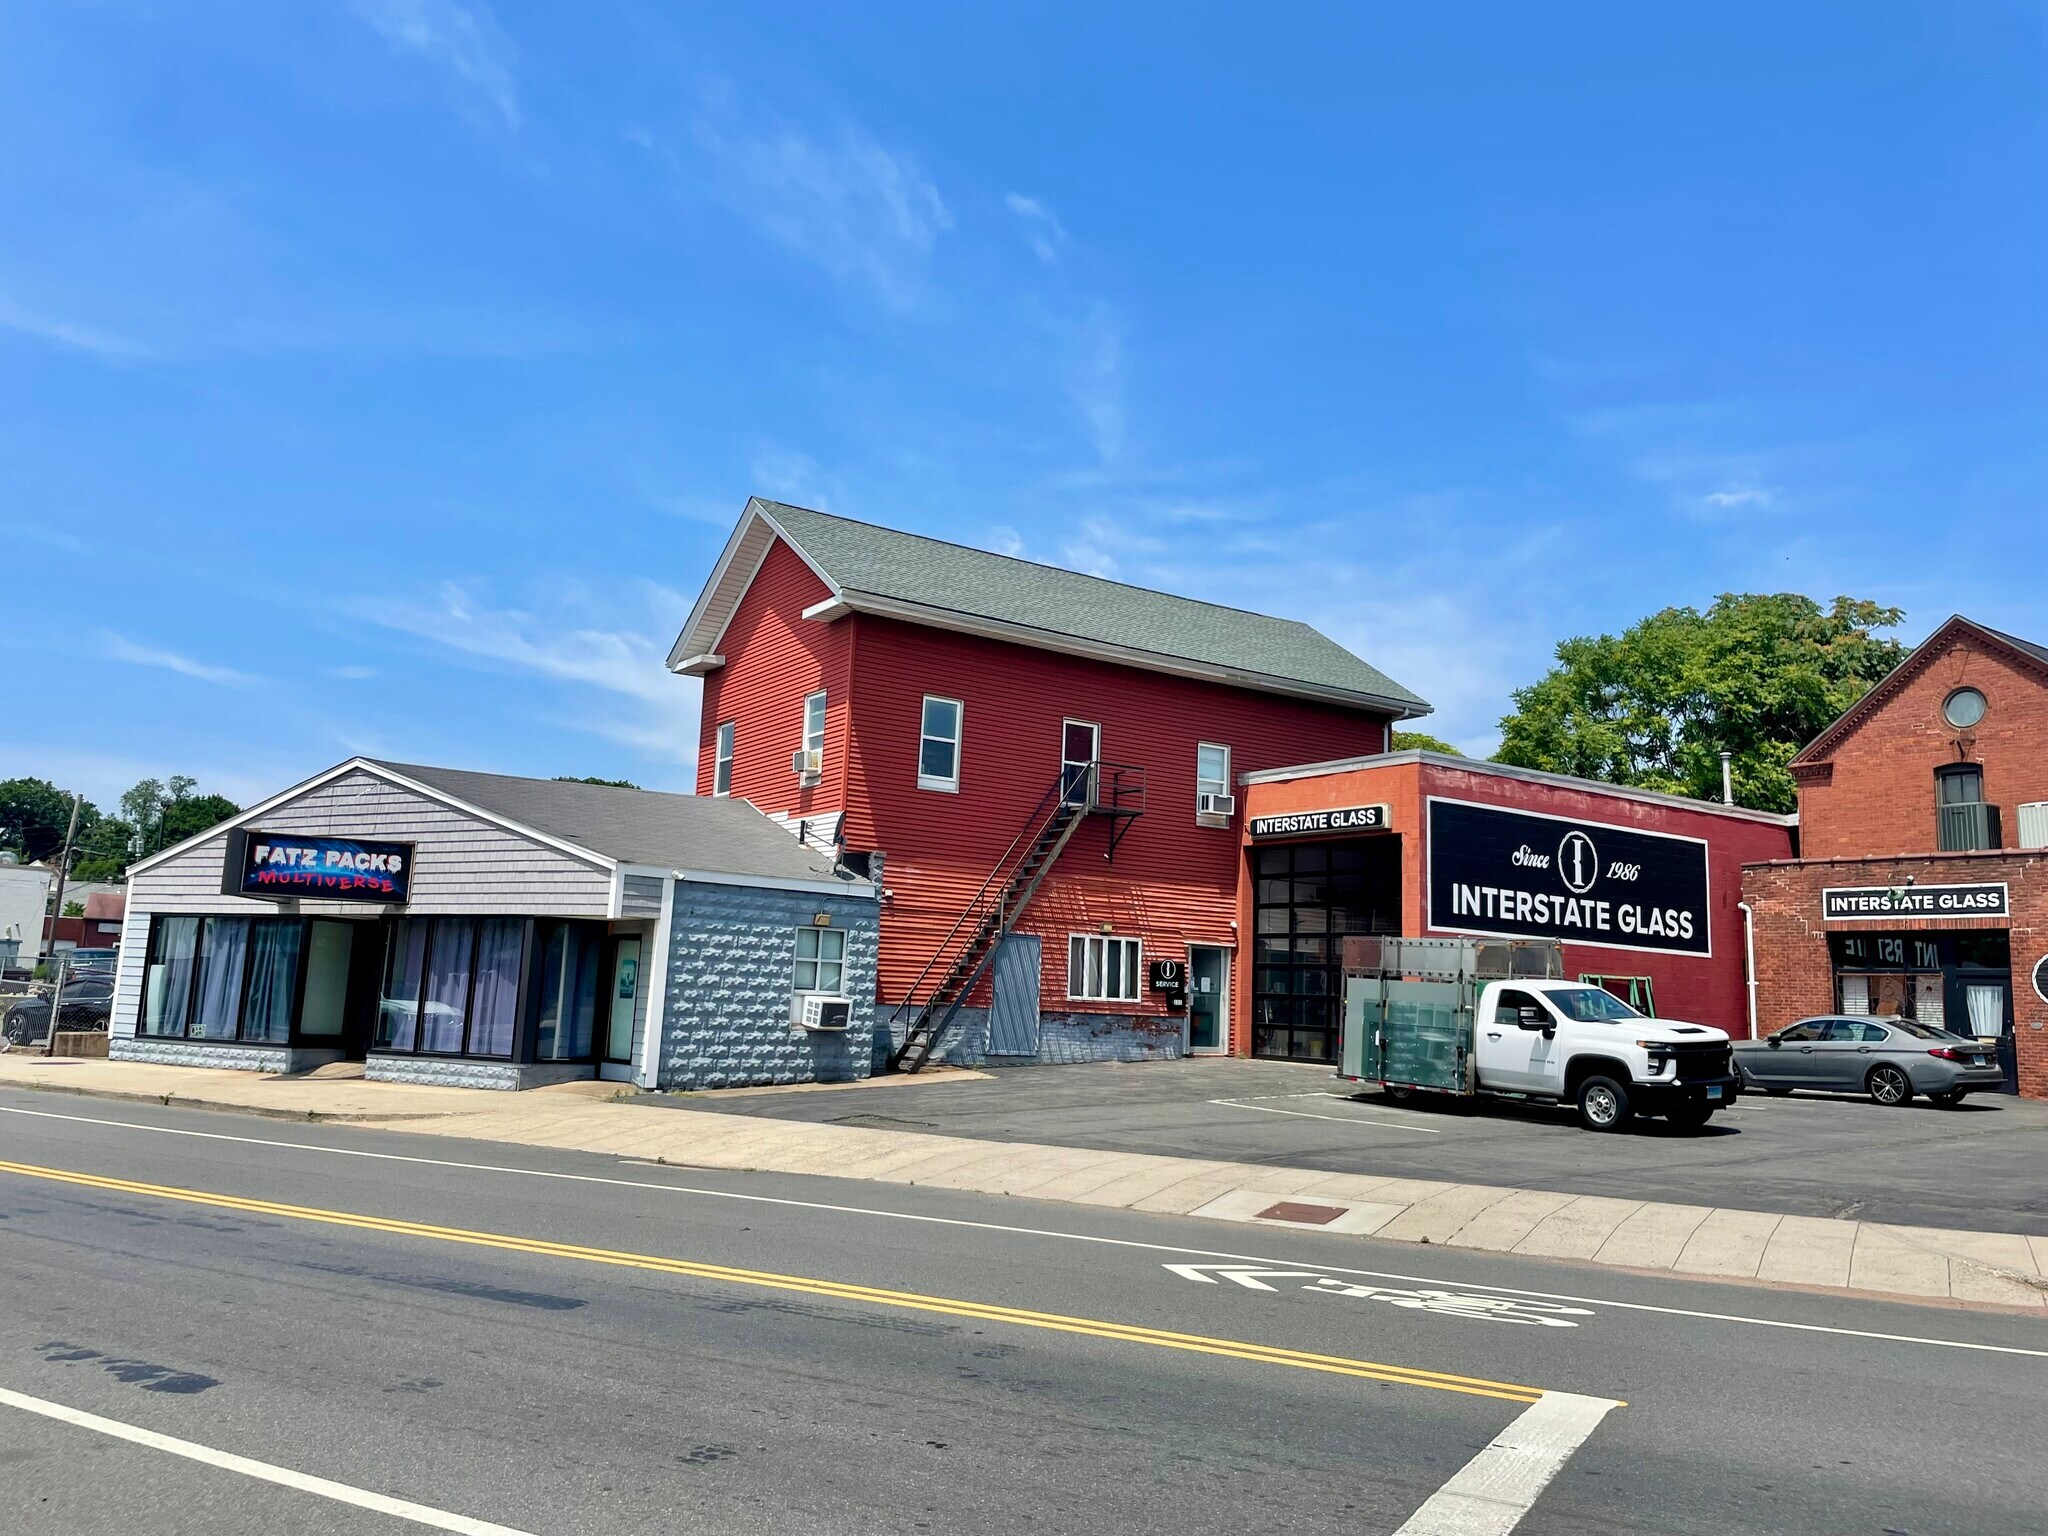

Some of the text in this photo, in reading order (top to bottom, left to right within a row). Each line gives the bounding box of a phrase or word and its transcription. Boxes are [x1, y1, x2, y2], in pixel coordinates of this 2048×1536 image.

[1256, 809, 1376, 834] INTERSTATE GLASS
[254, 844, 402, 875] FATZ PACKS
[1512, 844, 1641, 882] Since 1986
[258, 870, 395, 892] MULTIVERSE
[1452, 882, 1694, 940] INTERSTATE GLASS
[1938, 893, 2000, 908] GLASS
